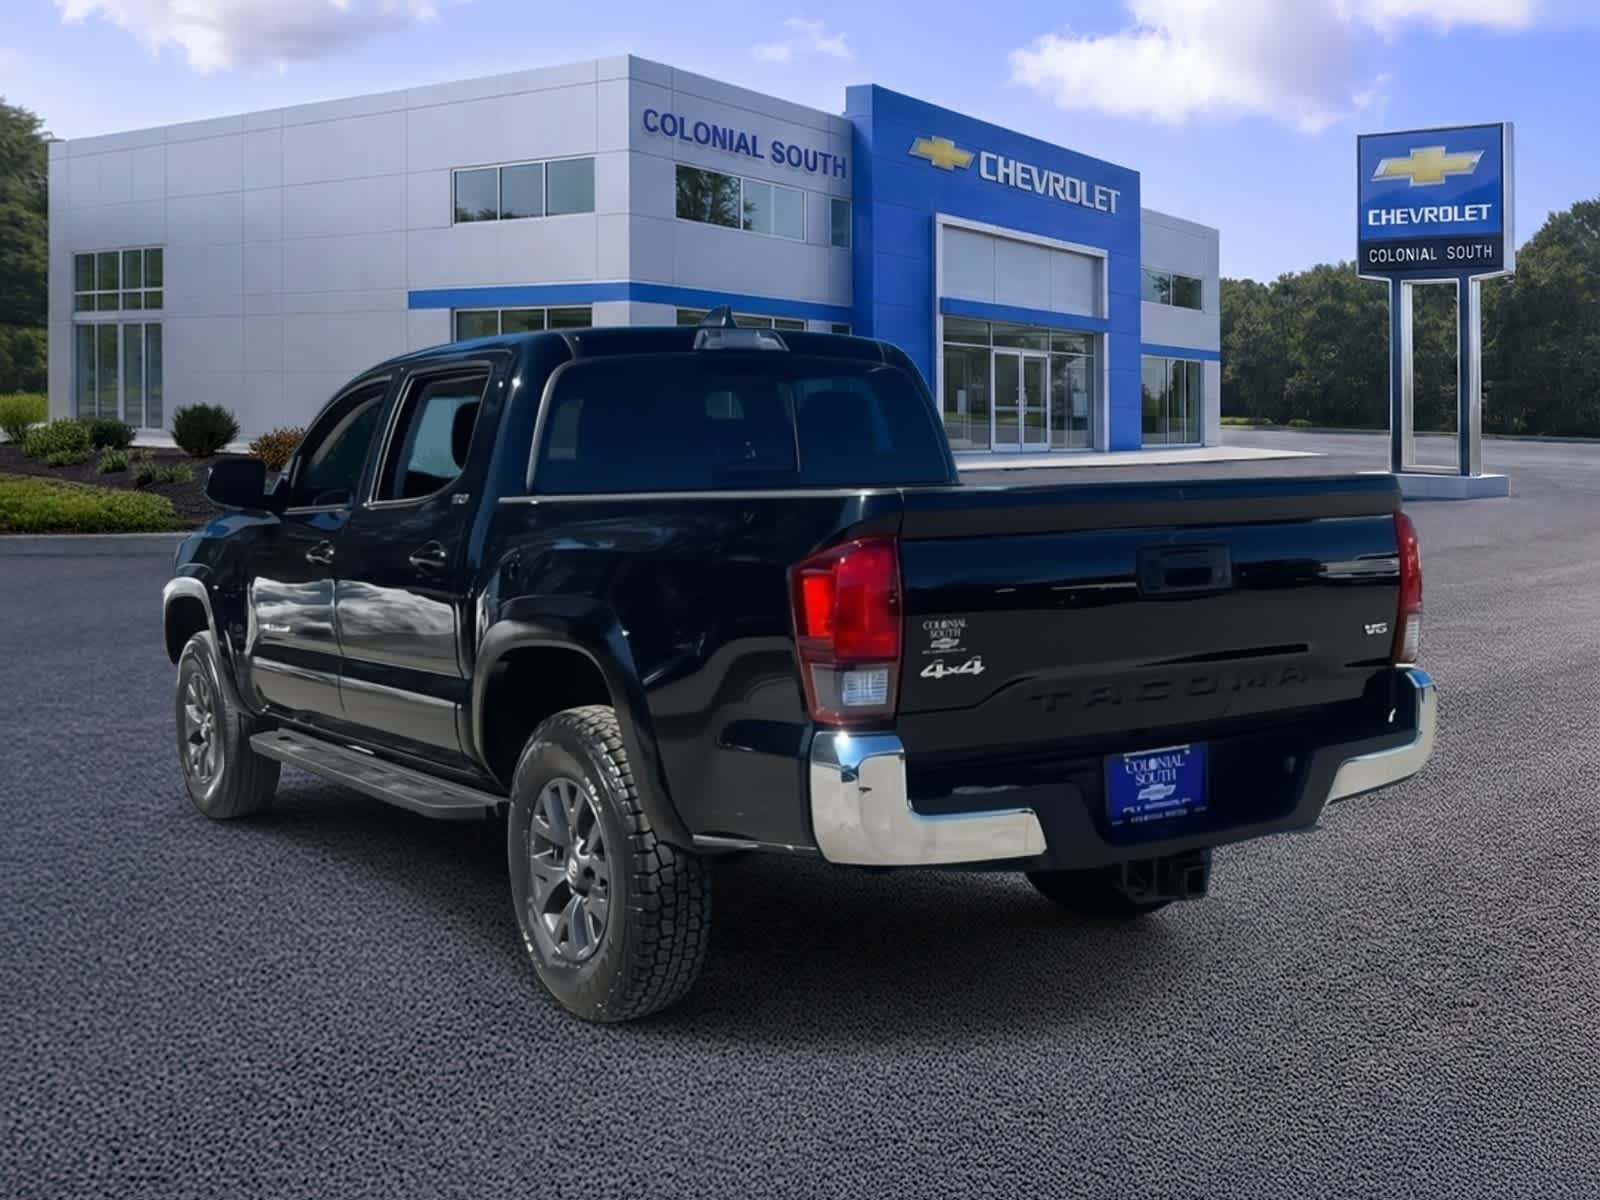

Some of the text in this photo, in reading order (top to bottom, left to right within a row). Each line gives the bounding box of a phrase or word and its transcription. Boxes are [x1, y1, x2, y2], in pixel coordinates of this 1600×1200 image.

[643, 108, 848, 179] COLONIAL SOUTH
[979, 150, 1121, 214] CHEVROLET
[1368, 203, 1492, 226] CHEVROLET
[1368, 244, 1493, 263] COLONIAL SOUTH
[1364, 622, 1388, 635] V6
[1029, 667, 1309, 712] TACOMA
[1125, 753, 1185, 775] COLONIAL
[1135, 767, 1177, 786] SOUTH
